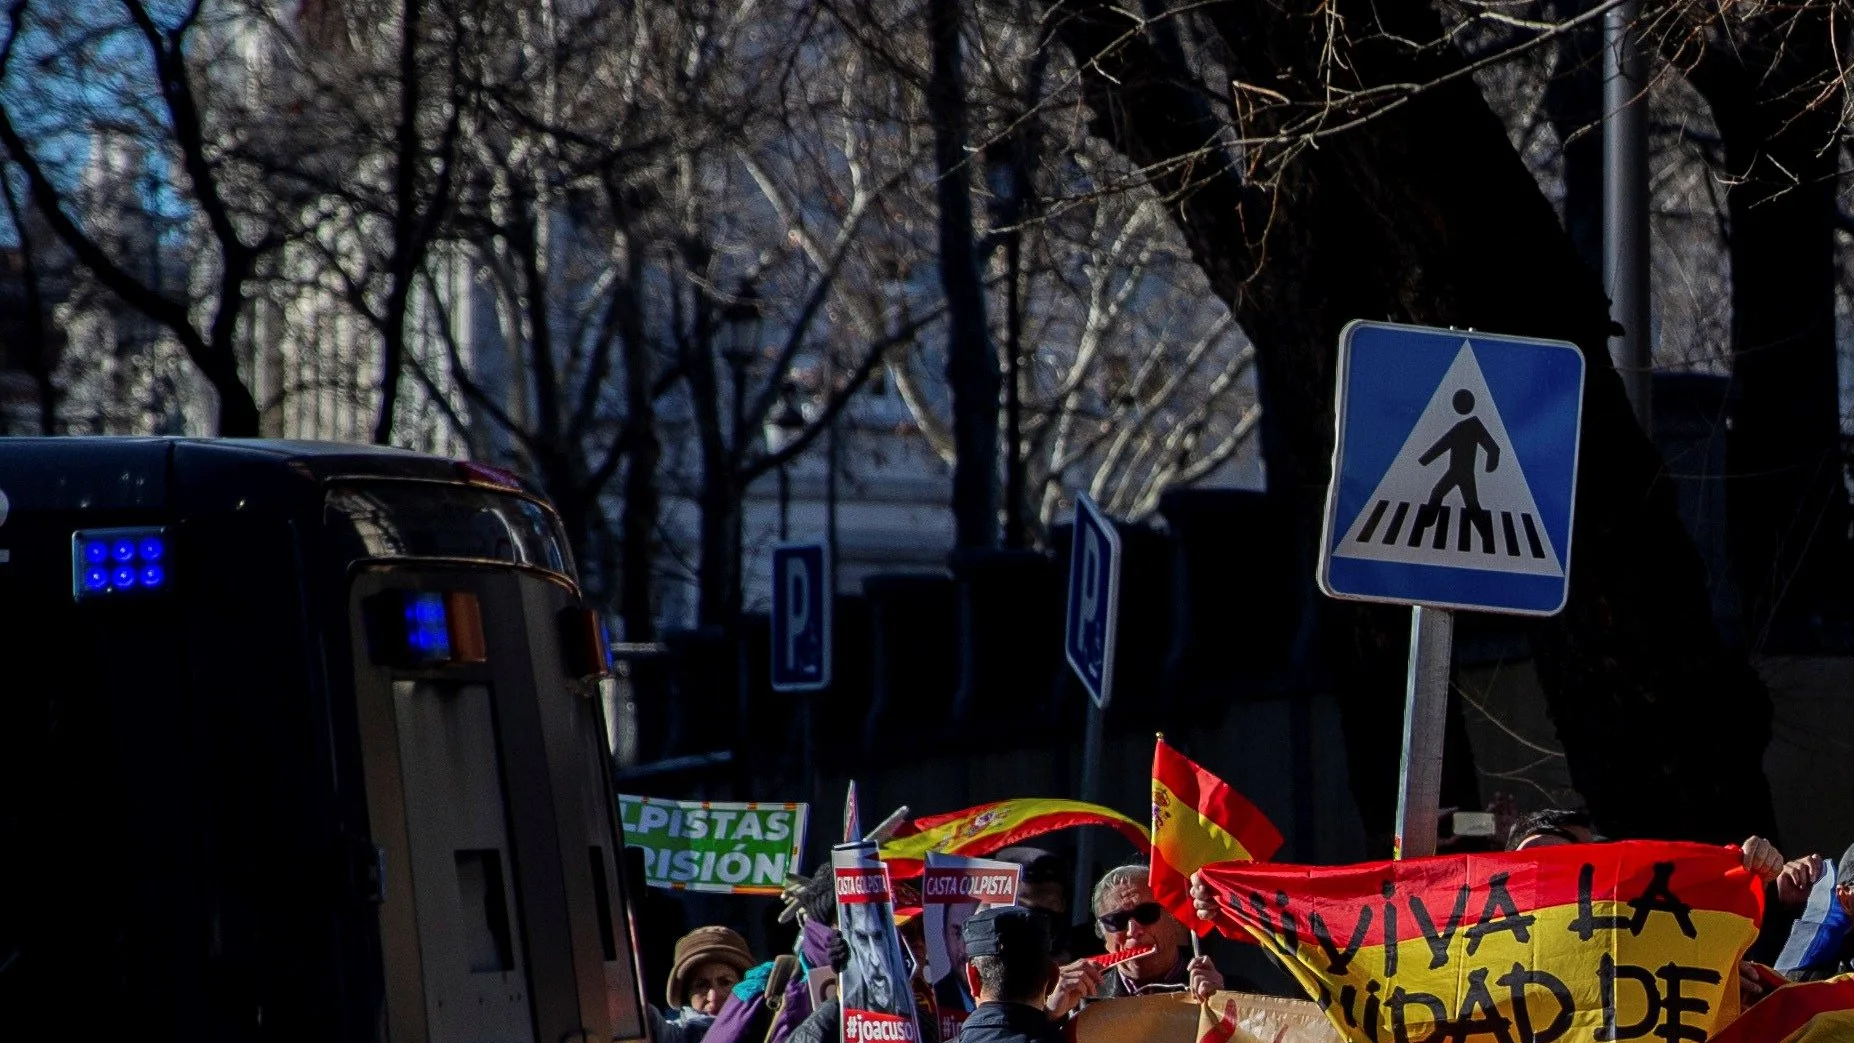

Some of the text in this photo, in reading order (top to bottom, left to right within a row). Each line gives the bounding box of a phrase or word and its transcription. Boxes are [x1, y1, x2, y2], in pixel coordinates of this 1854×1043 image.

[785, 556, 811, 672] P
[1077, 520, 1100, 652] P
[926, 876, 957, 896] CASTA
[1568, 862, 1697, 940] LA
